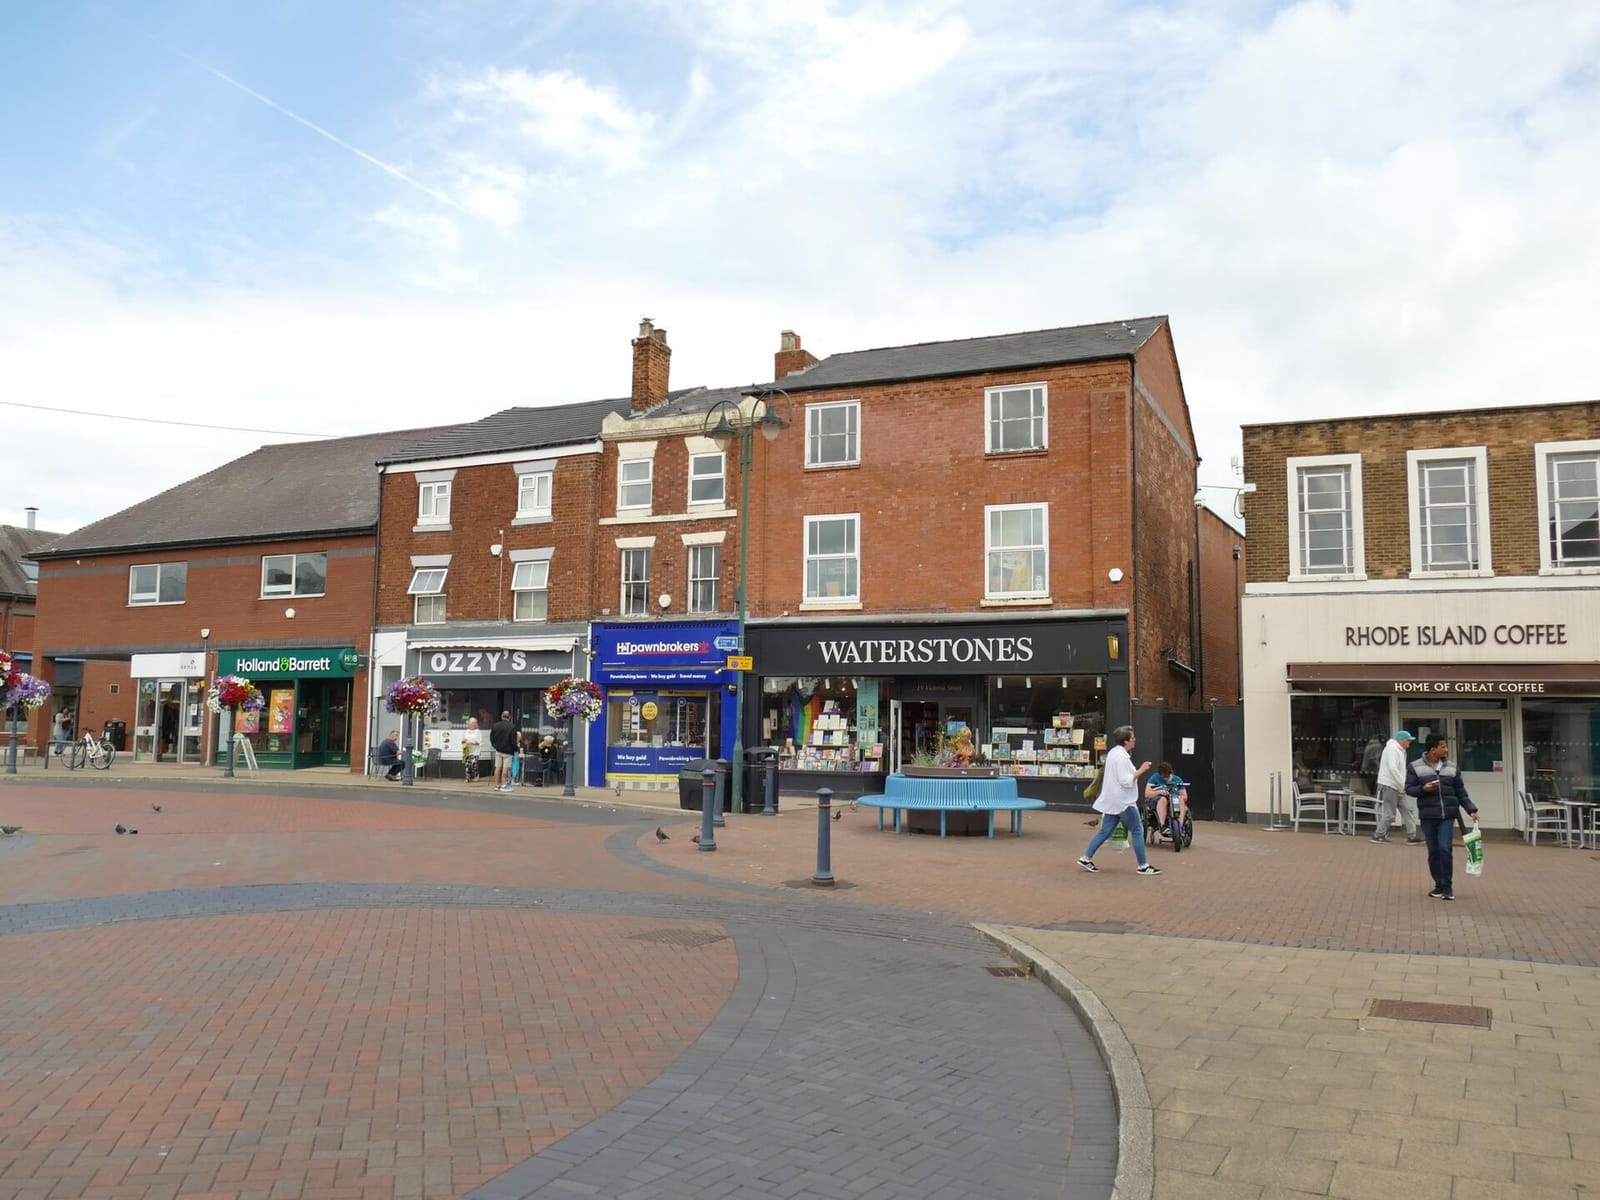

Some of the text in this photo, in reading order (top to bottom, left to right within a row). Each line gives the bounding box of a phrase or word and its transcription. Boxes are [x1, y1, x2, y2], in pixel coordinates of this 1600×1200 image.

[1345, 624, 1568, 646] RHODE ISLAND COFFEE
[818, 637, 1034, 664] WATERSTONES
[430, 651, 527, 672] OZZY'S
[1394, 682, 1545, 693] HOME OF GREAT COFFEE
